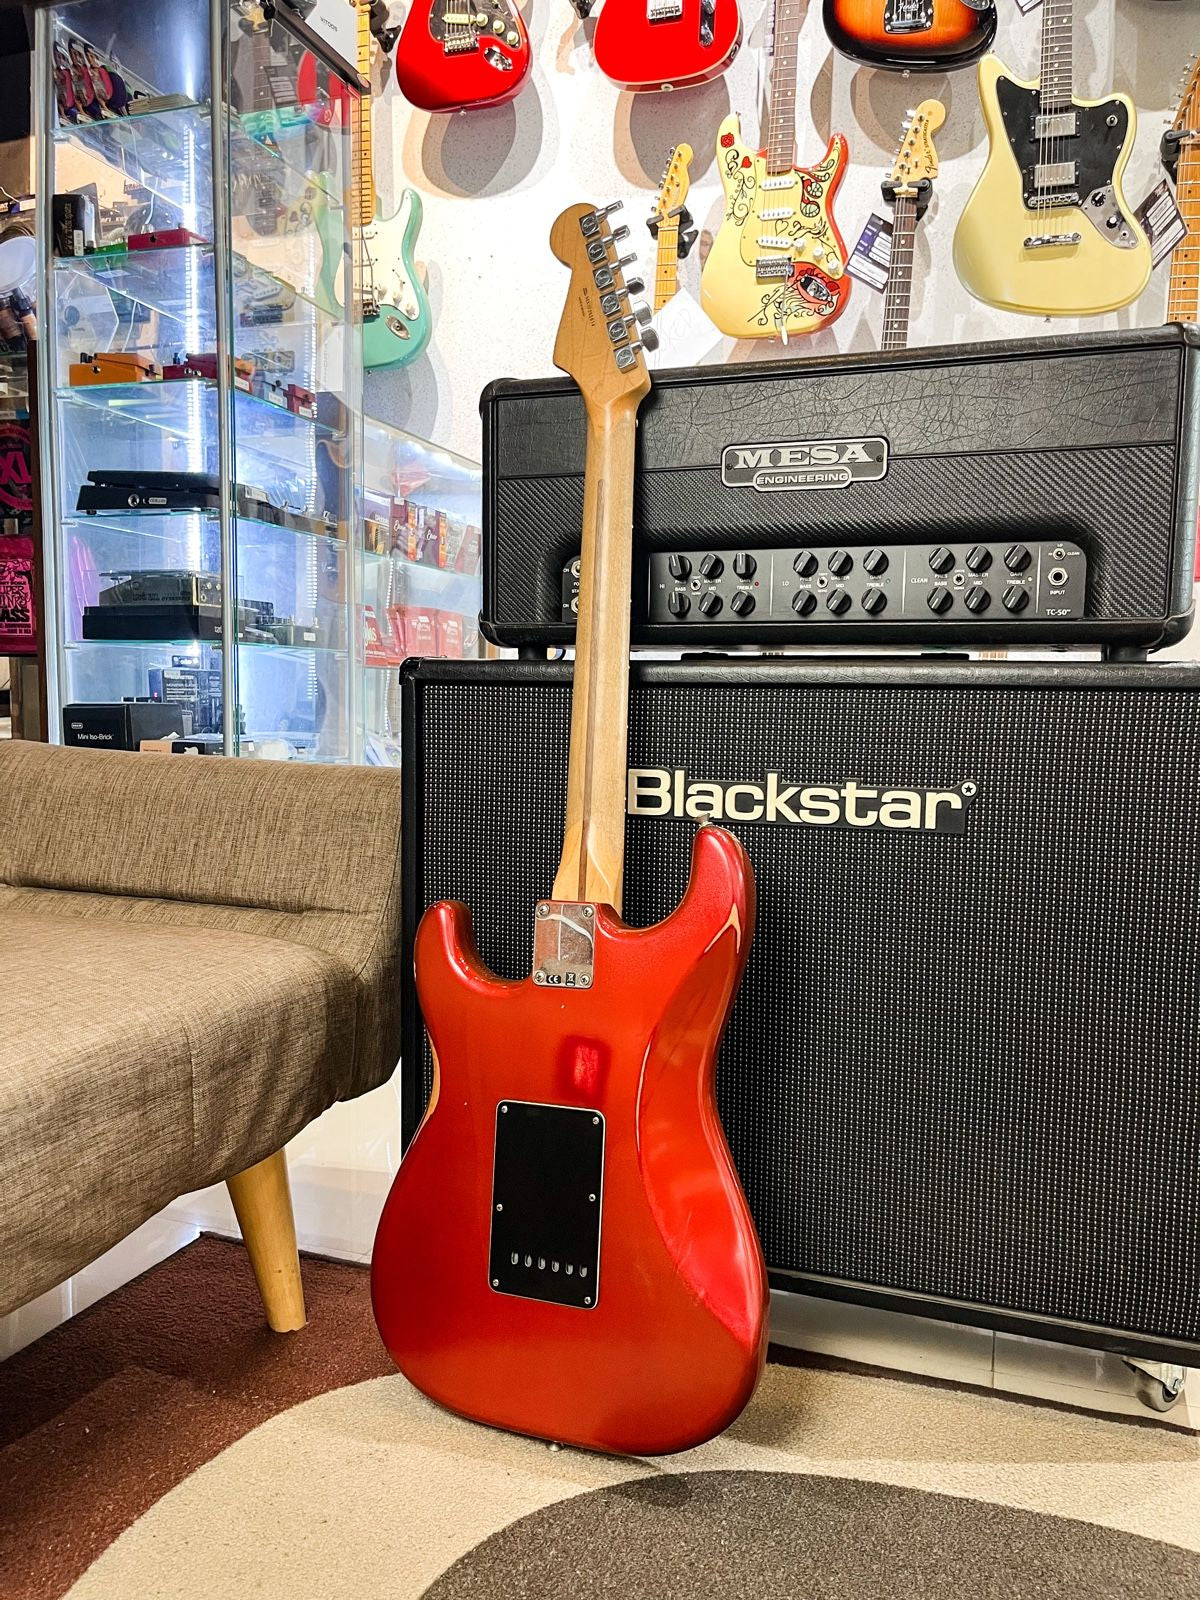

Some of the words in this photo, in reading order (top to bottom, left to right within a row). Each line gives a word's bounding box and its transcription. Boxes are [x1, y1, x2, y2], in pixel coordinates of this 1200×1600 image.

[733, 442, 874, 470] MESA
[756, 472, 849, 486] ENGINEERING
[627, 768, 963, 830] Blackstar
